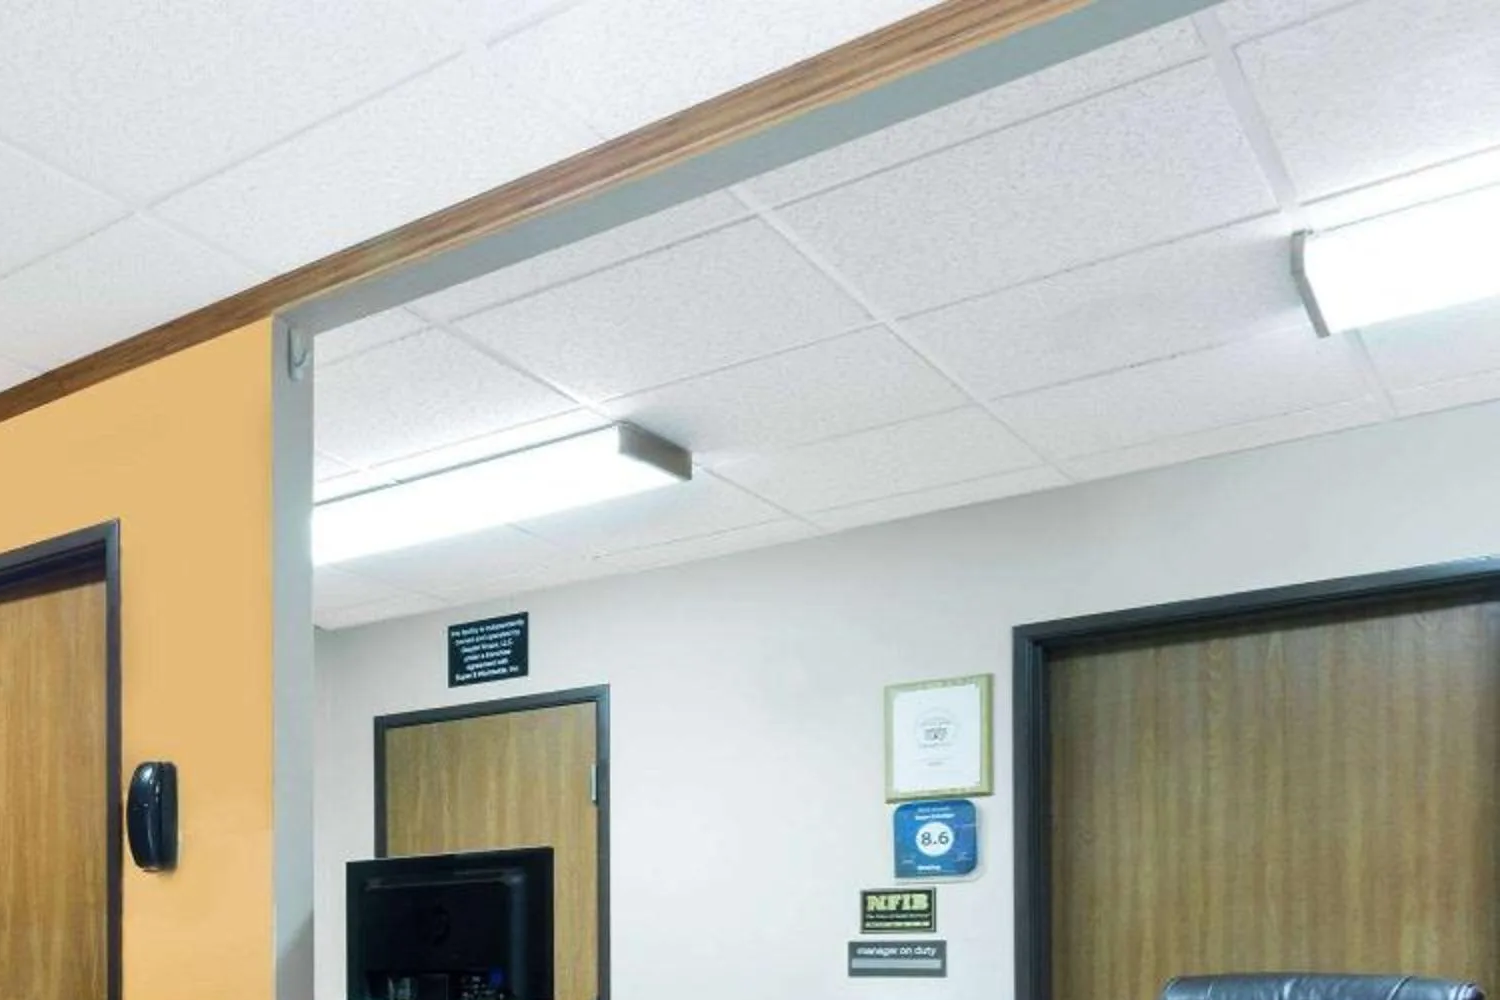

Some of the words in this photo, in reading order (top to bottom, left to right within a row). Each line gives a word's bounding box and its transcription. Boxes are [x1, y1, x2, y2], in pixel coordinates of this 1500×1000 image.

[920, 831, 951, 848] 8.6
[865, 893, 930, 911] NFIB
[900, 946, 913, 955] on
[914, 946, 937, 957] duty
